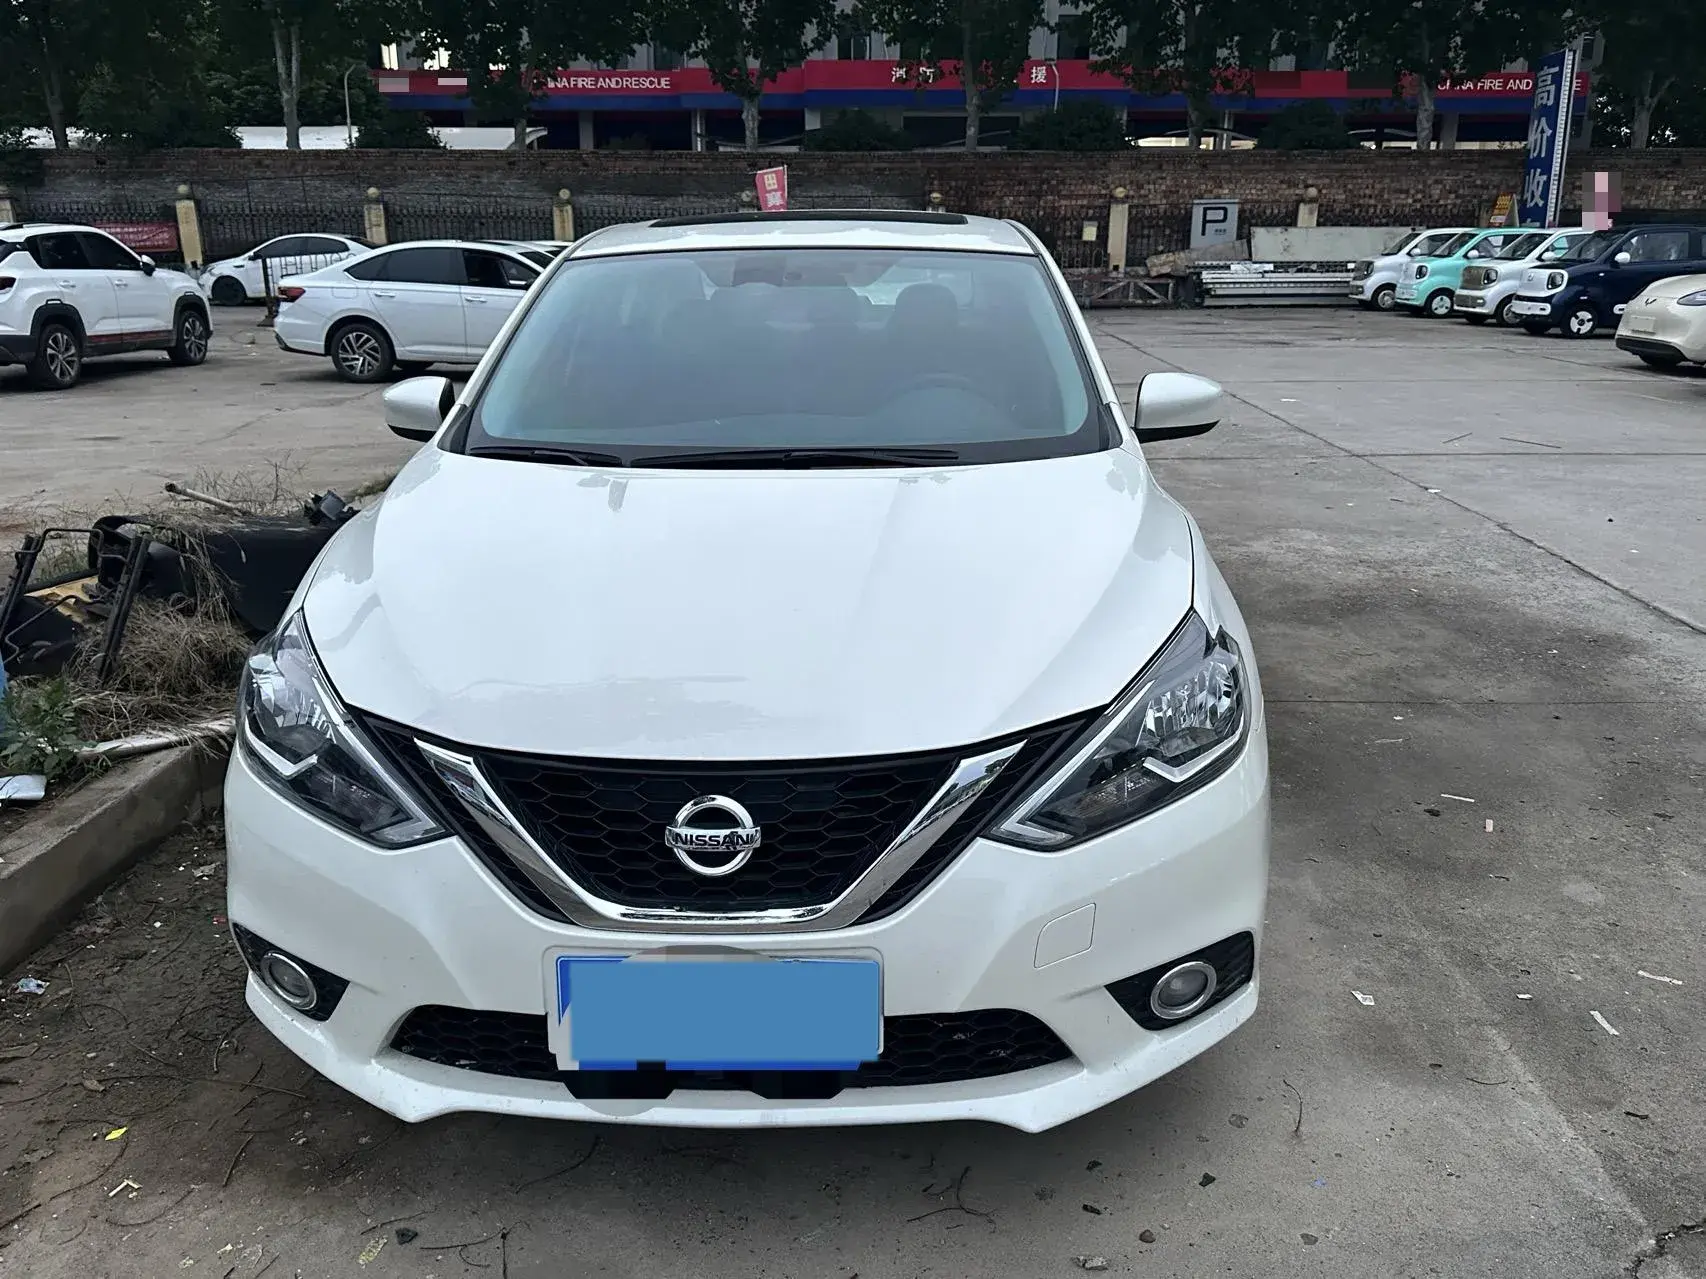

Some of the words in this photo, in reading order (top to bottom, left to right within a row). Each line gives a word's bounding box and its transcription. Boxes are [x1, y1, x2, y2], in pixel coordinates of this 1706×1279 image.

[570, 76, 596, 89] FIRE
[596, 76, 622, 89] AND
[622, 76, 671, 89] RESCUE
[1476, 78, 1504, 91] FIRE
[1505, 78, 1533, 91] AND
[1201, 206, 1228, 237] P
[674, 831, 750, 847] NISSAN
